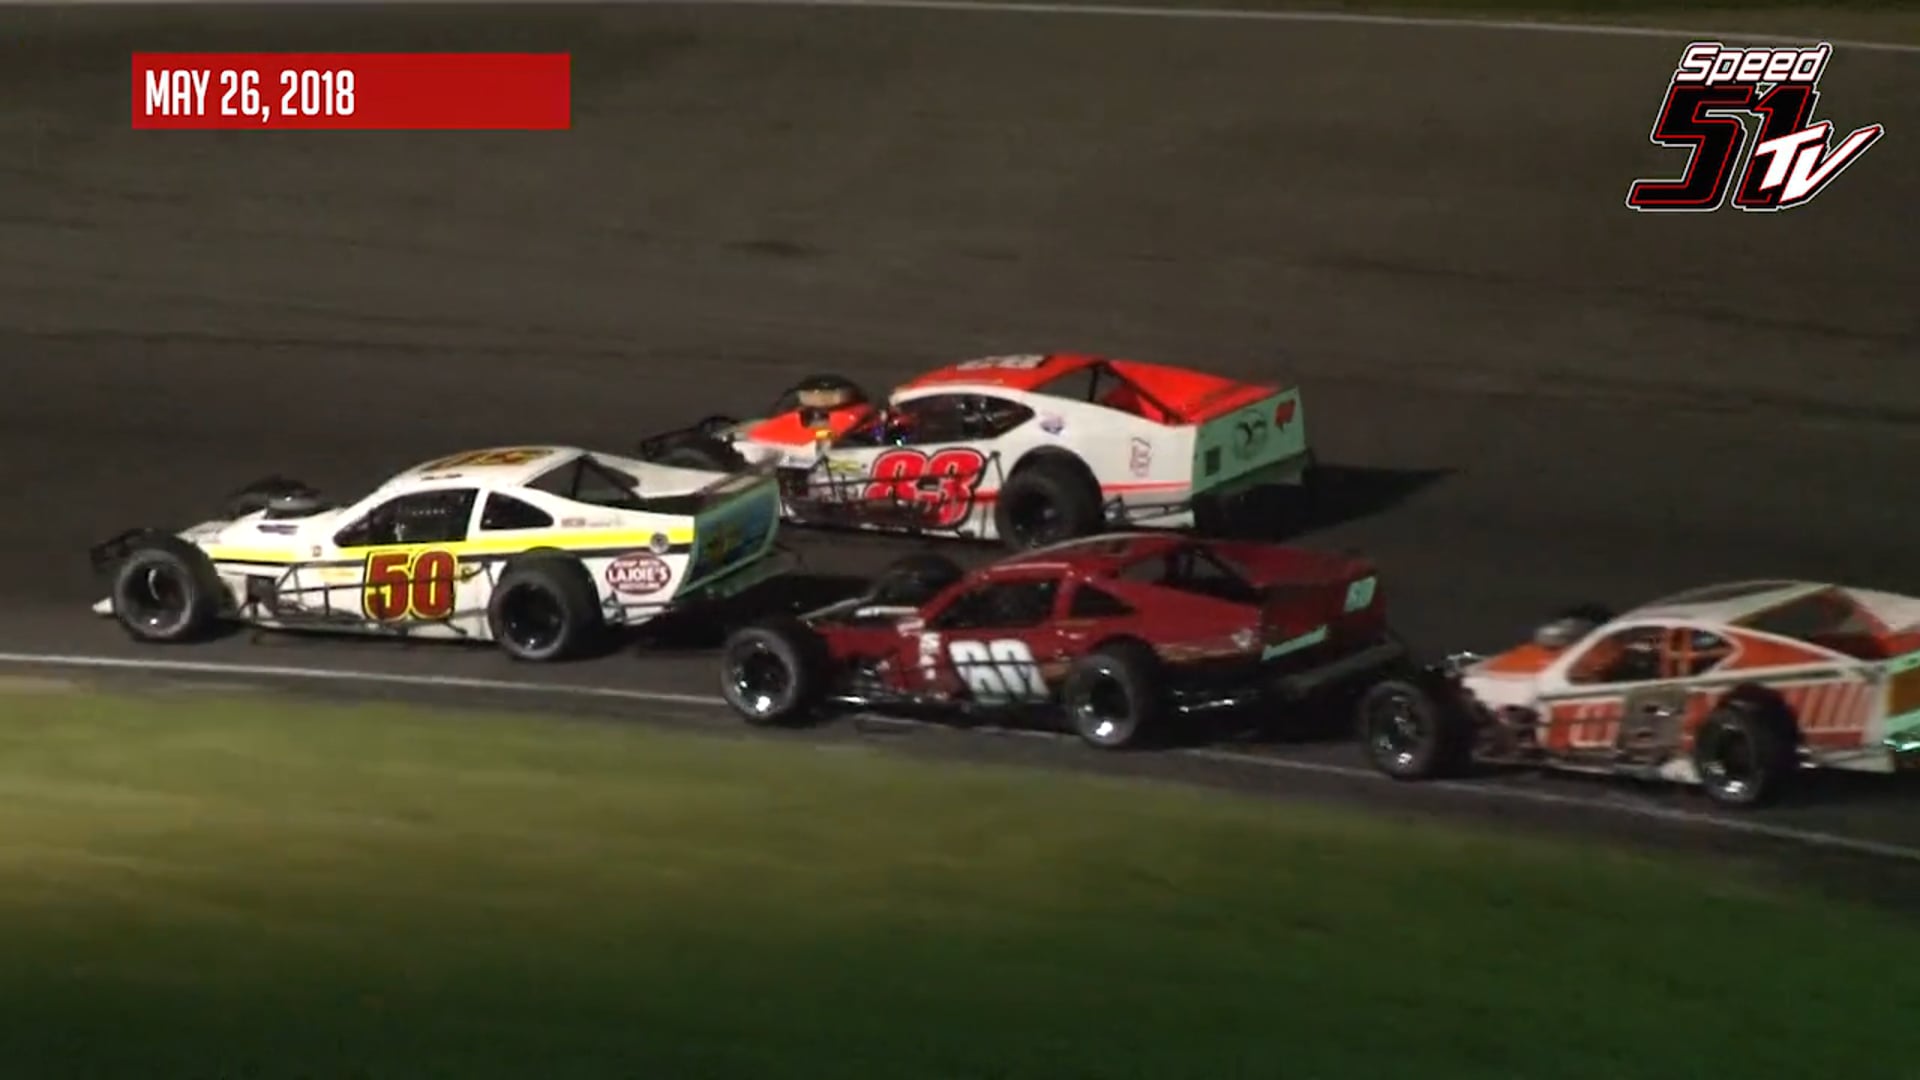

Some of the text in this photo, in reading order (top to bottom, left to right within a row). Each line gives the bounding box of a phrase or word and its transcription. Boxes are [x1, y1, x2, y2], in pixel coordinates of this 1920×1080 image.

[863, 447, 985, 528] 83
[363, 547, 458, 622] 50
[607, 566, 669, 583] LAJOIE'S
